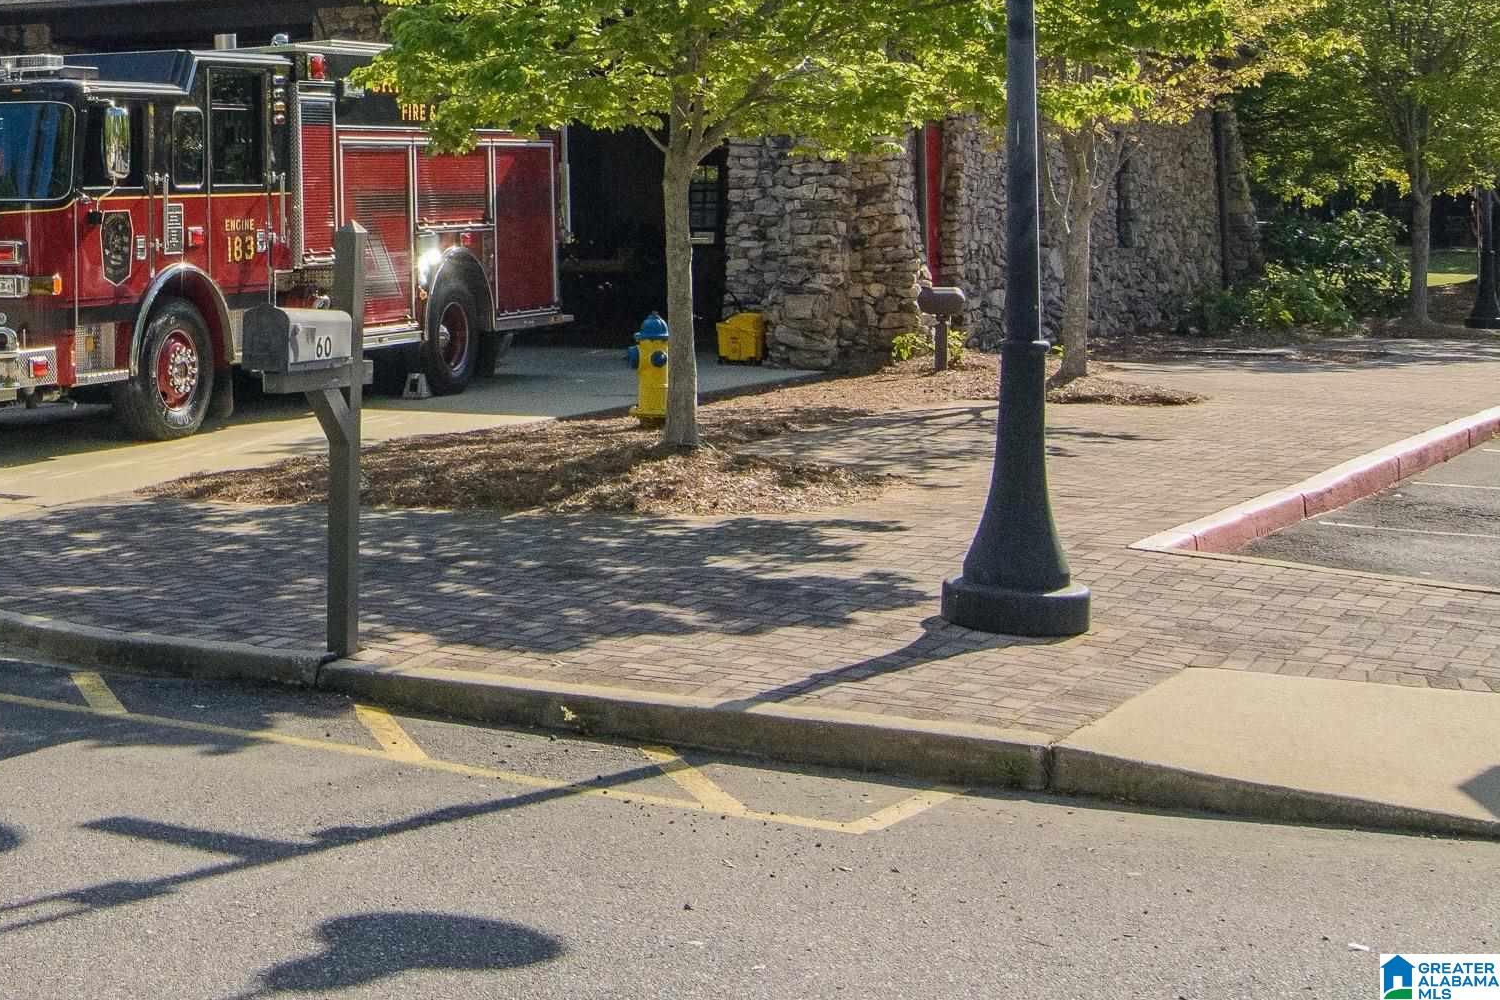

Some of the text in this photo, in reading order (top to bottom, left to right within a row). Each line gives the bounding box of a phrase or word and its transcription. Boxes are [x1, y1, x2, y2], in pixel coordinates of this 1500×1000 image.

[401, 103, 437, 121] FIRE &
[225, 218, 255, 232] ENGINE
[227, 235, 255, 263] 183
[316, 336, 332, 358] 60
